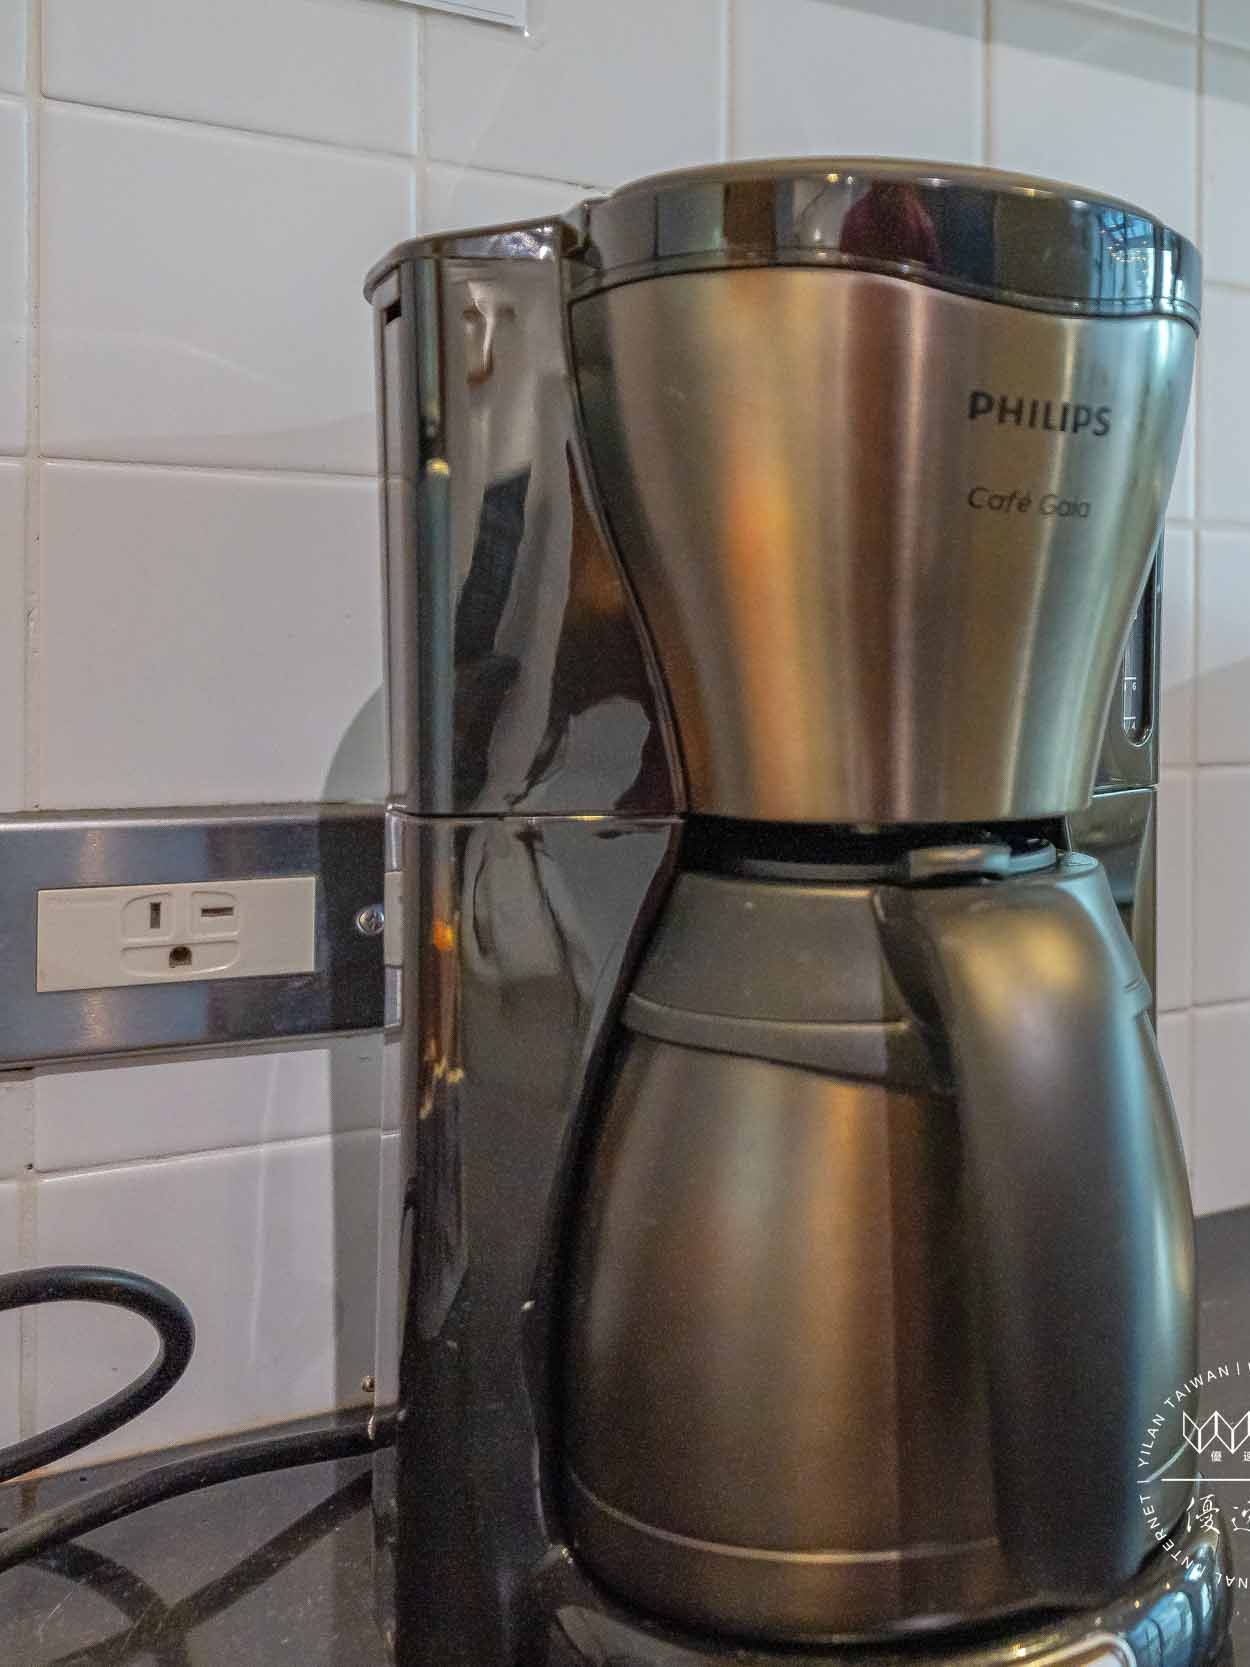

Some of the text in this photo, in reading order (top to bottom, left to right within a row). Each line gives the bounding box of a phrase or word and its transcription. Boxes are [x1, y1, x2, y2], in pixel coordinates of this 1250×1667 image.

[968, 390, 1113, 436] PHILIPS
[967, 486, 1092, 518] Café Gaia
